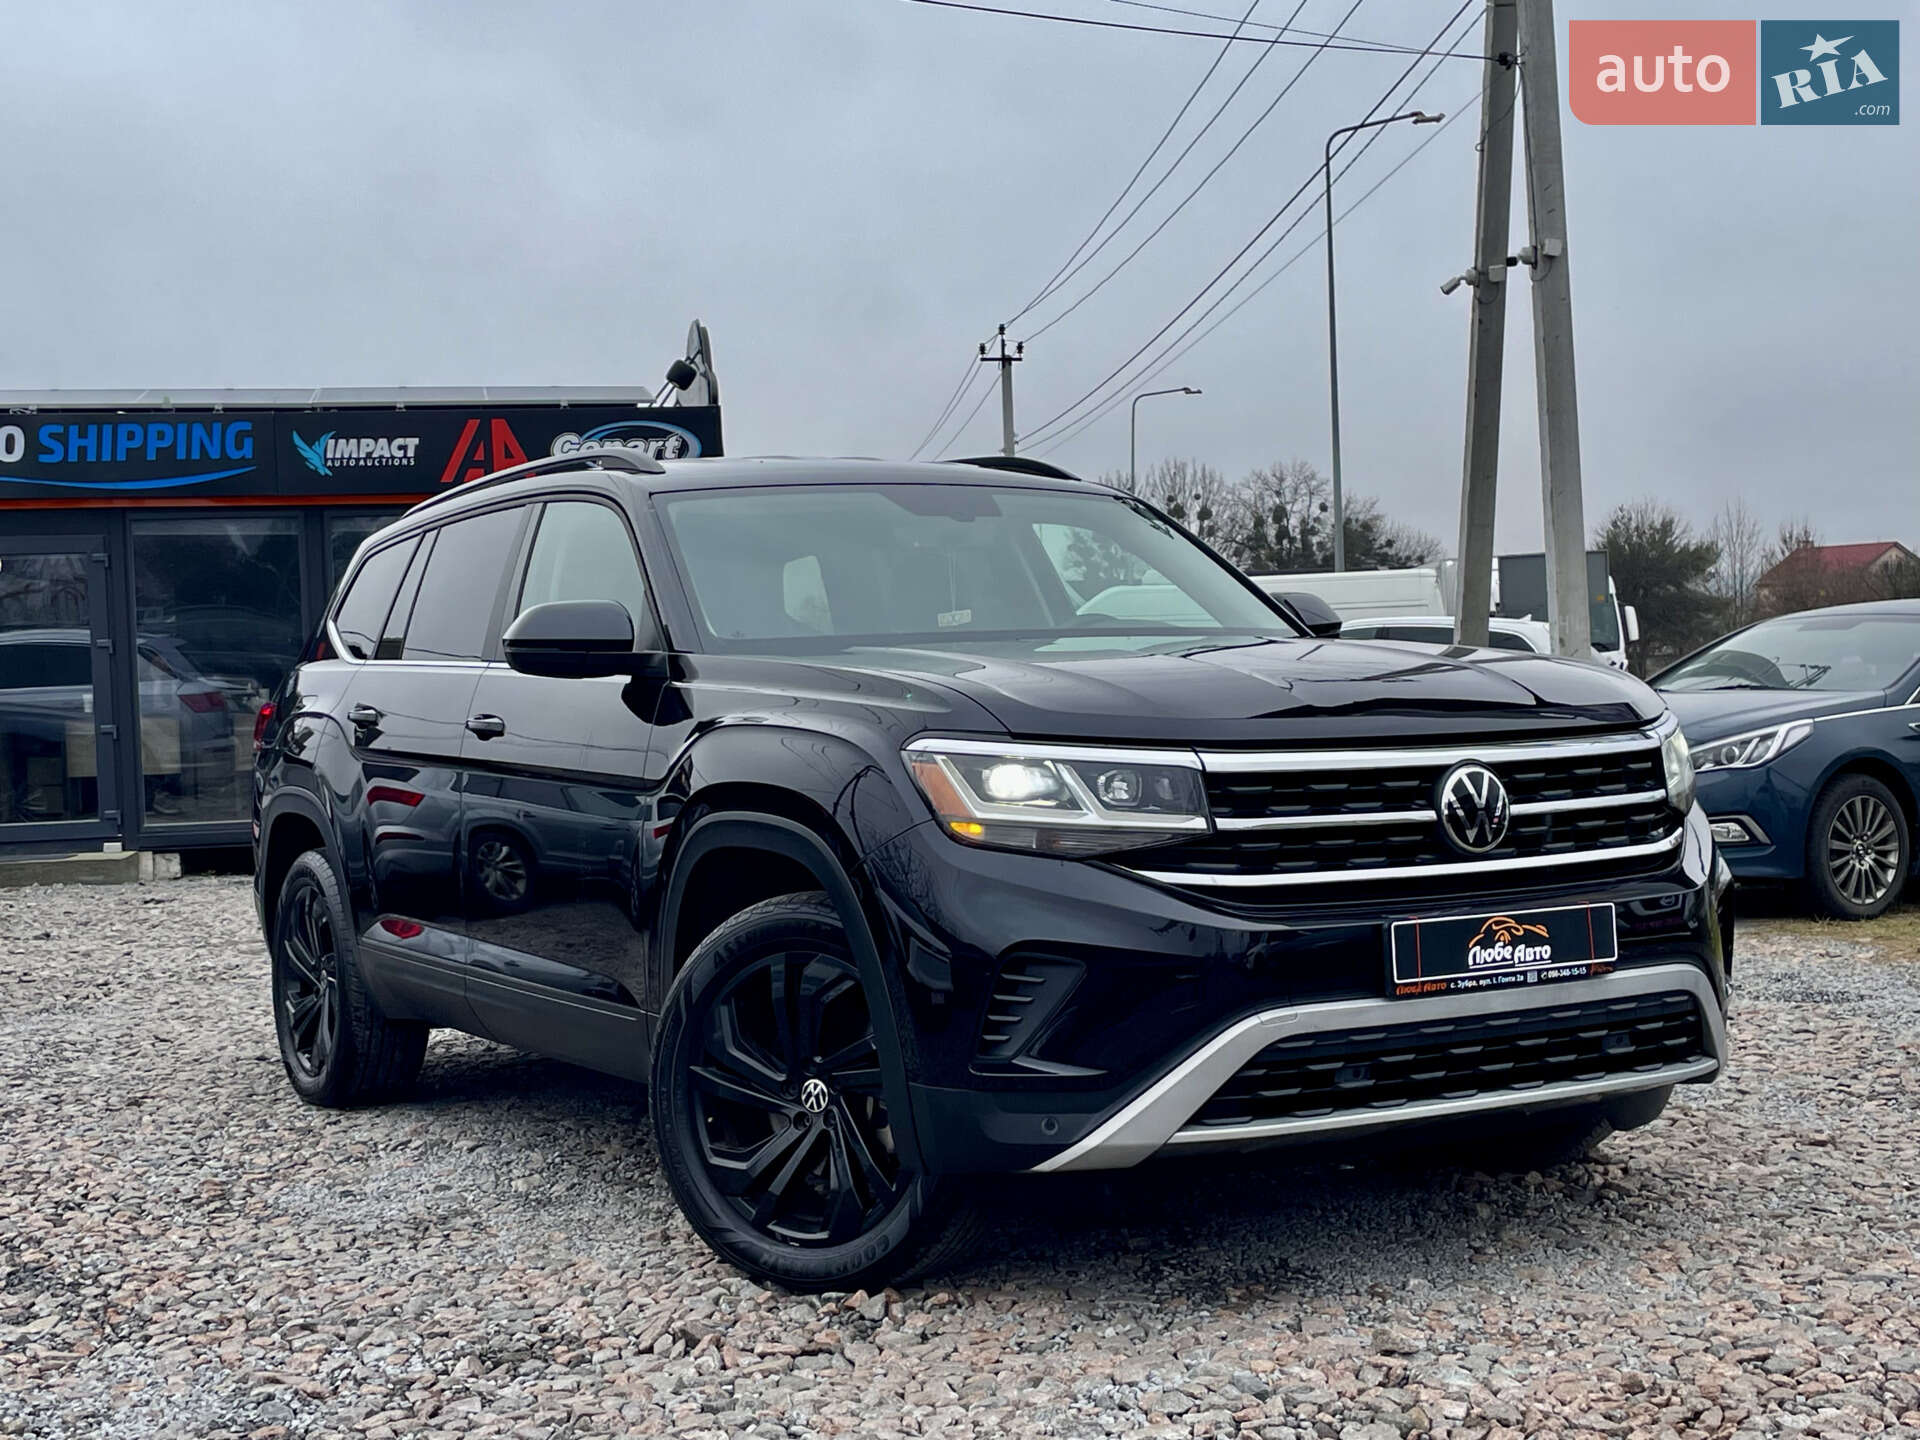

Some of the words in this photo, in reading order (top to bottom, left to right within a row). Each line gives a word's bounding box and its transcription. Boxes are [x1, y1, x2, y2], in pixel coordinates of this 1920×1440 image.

[37, 421, 254, 464] SHIPPING
[326, 437, 420, 459] IMPACT
[1467, 941, 1514, 967] Любе
[1513, 943, 1552, 965] Авто
